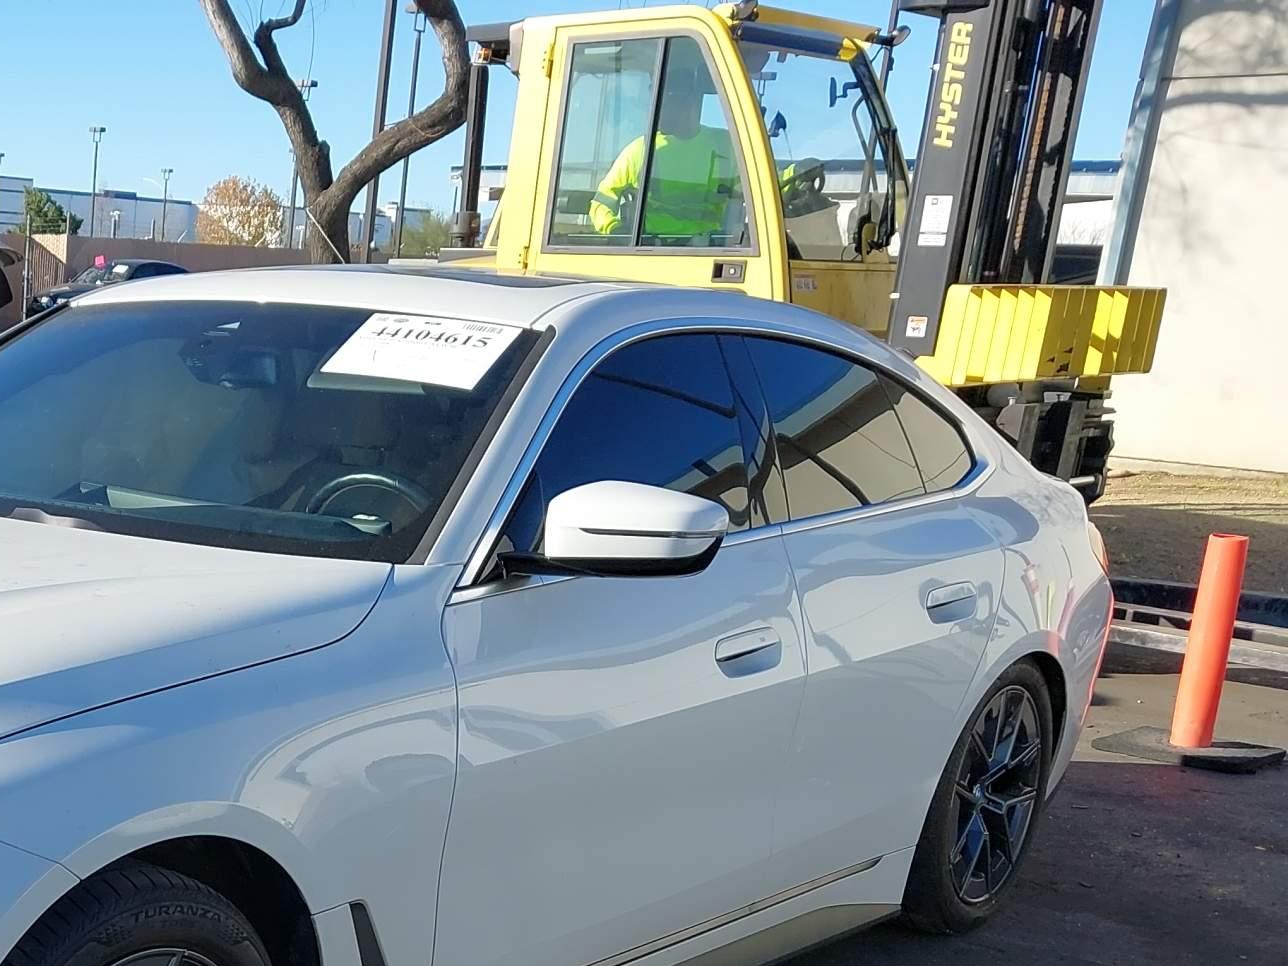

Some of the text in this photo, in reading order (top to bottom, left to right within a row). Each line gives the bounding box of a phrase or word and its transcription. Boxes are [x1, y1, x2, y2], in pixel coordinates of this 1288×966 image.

[933, 22, 973, 148] HYSTER
[372, 326, 493, 348] 44104615
[132, 904, 221, 923] TURANZA
